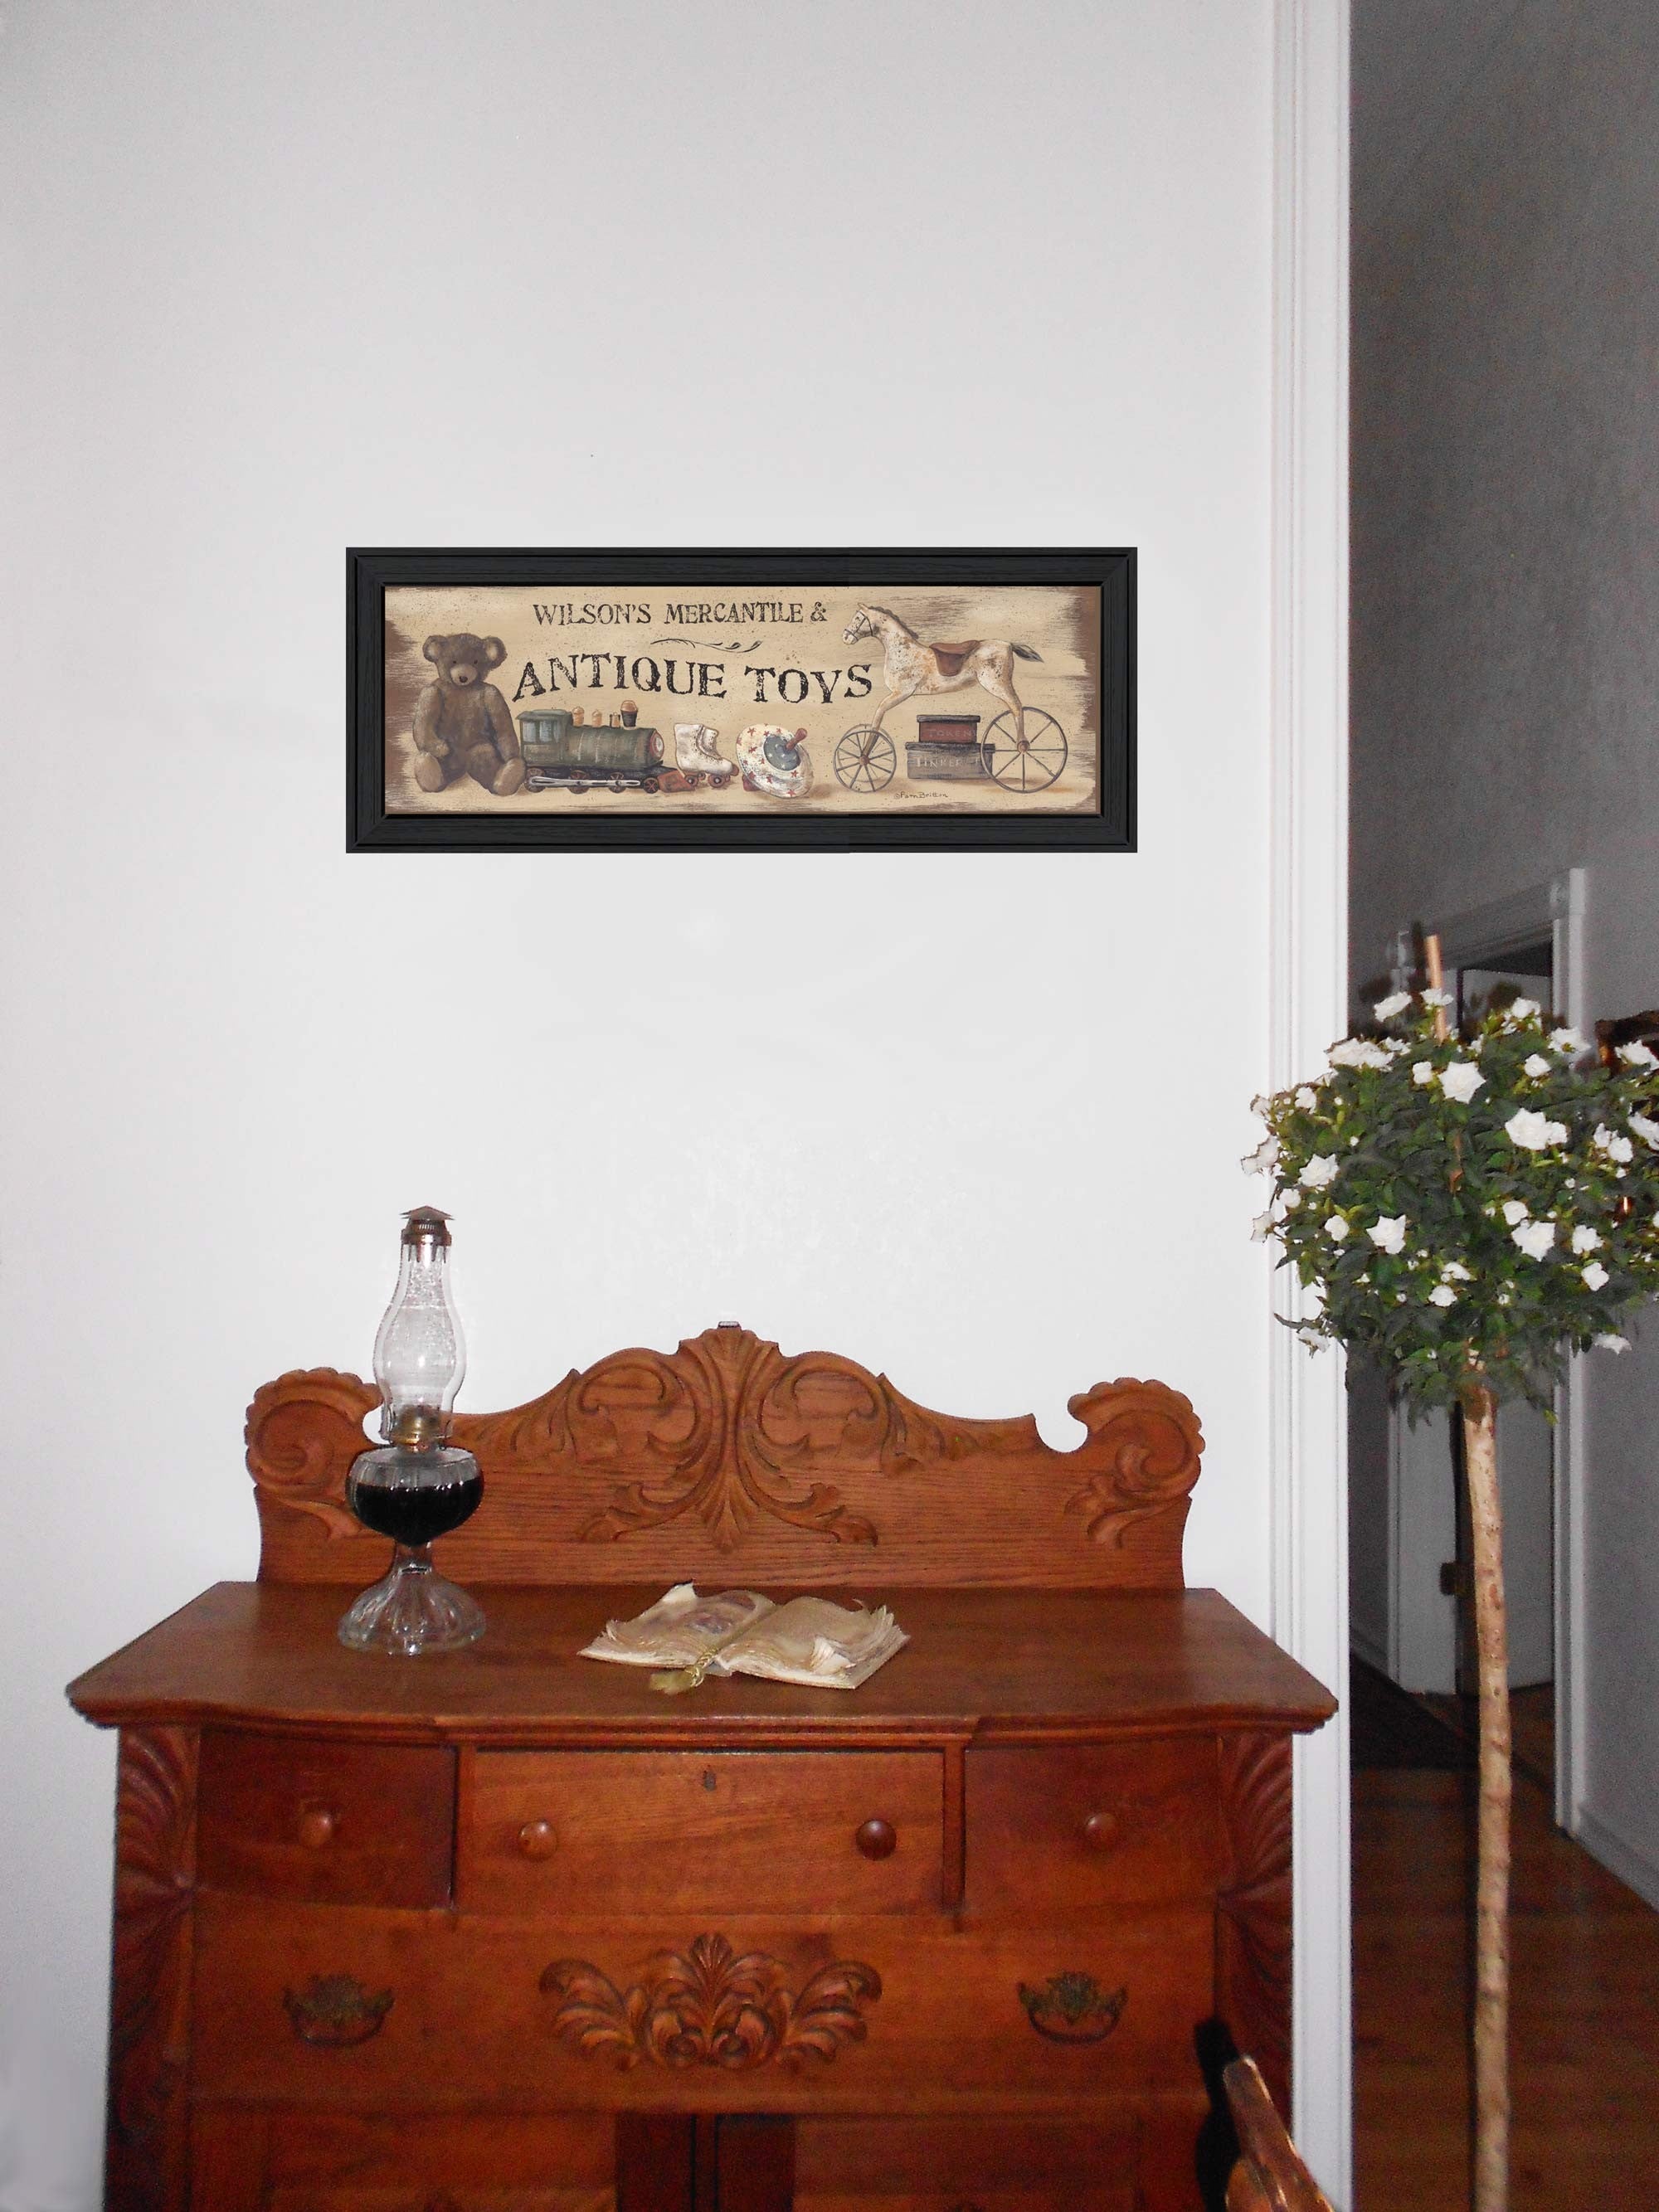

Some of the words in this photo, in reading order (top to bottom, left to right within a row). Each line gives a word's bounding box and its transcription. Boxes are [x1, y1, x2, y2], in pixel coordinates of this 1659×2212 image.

[533, 604, 652, 625] WILSON'S
[665, 602, 803, 625] MERCANTILE
[810, 601, 829, 622] &
[512, 653, 727, 702] ANTIQUE
[744, 663, 872, 704] TOYS
